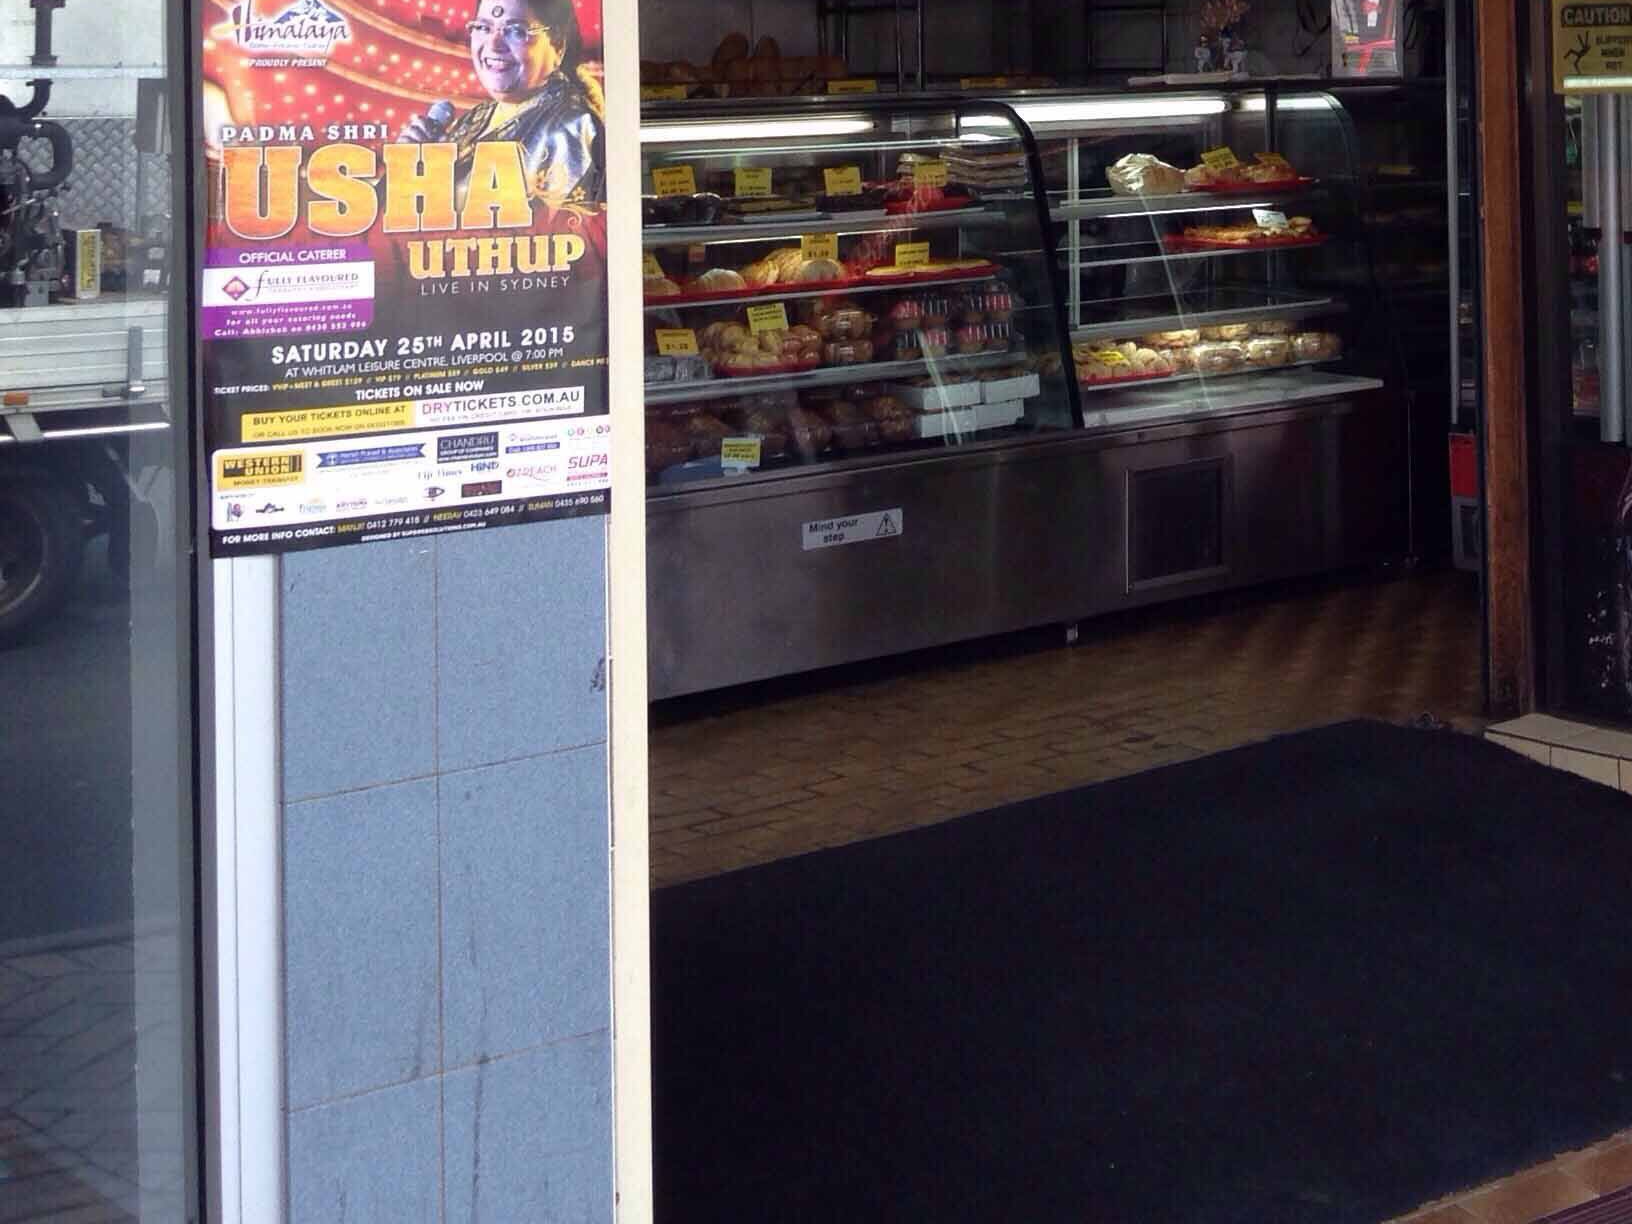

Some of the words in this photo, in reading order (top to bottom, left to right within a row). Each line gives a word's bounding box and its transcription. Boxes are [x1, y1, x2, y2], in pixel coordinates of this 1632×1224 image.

[1563, 7, 1631, 25] CAUTION
[221, 124, 315, 143] PADMA
[327, 123, 389, 141] SHRI
[222, 140, 534, 241] USHA
[239, 251, 294, 264] OFFICIAL
[297, 248, 347, 262] CATERER
[408, 234, 586, 280] UTHUP
[421, 280, 460, 296] LIVE
[470, 280, 489, 293] IN
[500, 275, 570, 291] SYDNEY
[271, 338, 388, 365] SATURDAY
[397, 335, 443, 355] 25TH
[451, 330, 511, 352] APRIL
[521, 326, 575, 346] 2015
[285, 367, 300, 379] AT
[302, 363, 356, 378] WHITLAM
[358, 360, 401, 373] LEISURE
[451, 352, 509, 367] LIVERPOOL
[511, 350, 523, 362] @
[548, 347, 563, 358] PM
[473, 366, 494, 375] GOLD
[356, 387, 400, 401] TICKETS
[403, 385, 423, 397] ON
[426, 382, 452, 395] SALE
[455, 380, 484, 392] NOW
[253, 416, 276, 426] BUY
[279, 413, 307, 424] YOUR
[310, 410, 352, 422] TICKETS
[355, 407, 390, 417] ONLINE
[392, 405, 406, 413] AT
[440, 437, 496, 450] CHANDRU
[224, 456, 289, 470] WESTERN
[568, 453, 608, 469] SUPA
[244, 465, 290, 477] UNION
[809, 521, 834, 533] Mind
[836, 519, 859, 531] your
[222, 535, 241, 545] FOR
[243, 533, 270, 544] MORE
[271, 531, 293, 541] INFO
[295, 526, 336, 540] CONTACT:
[823, 533, 845, 544] step
